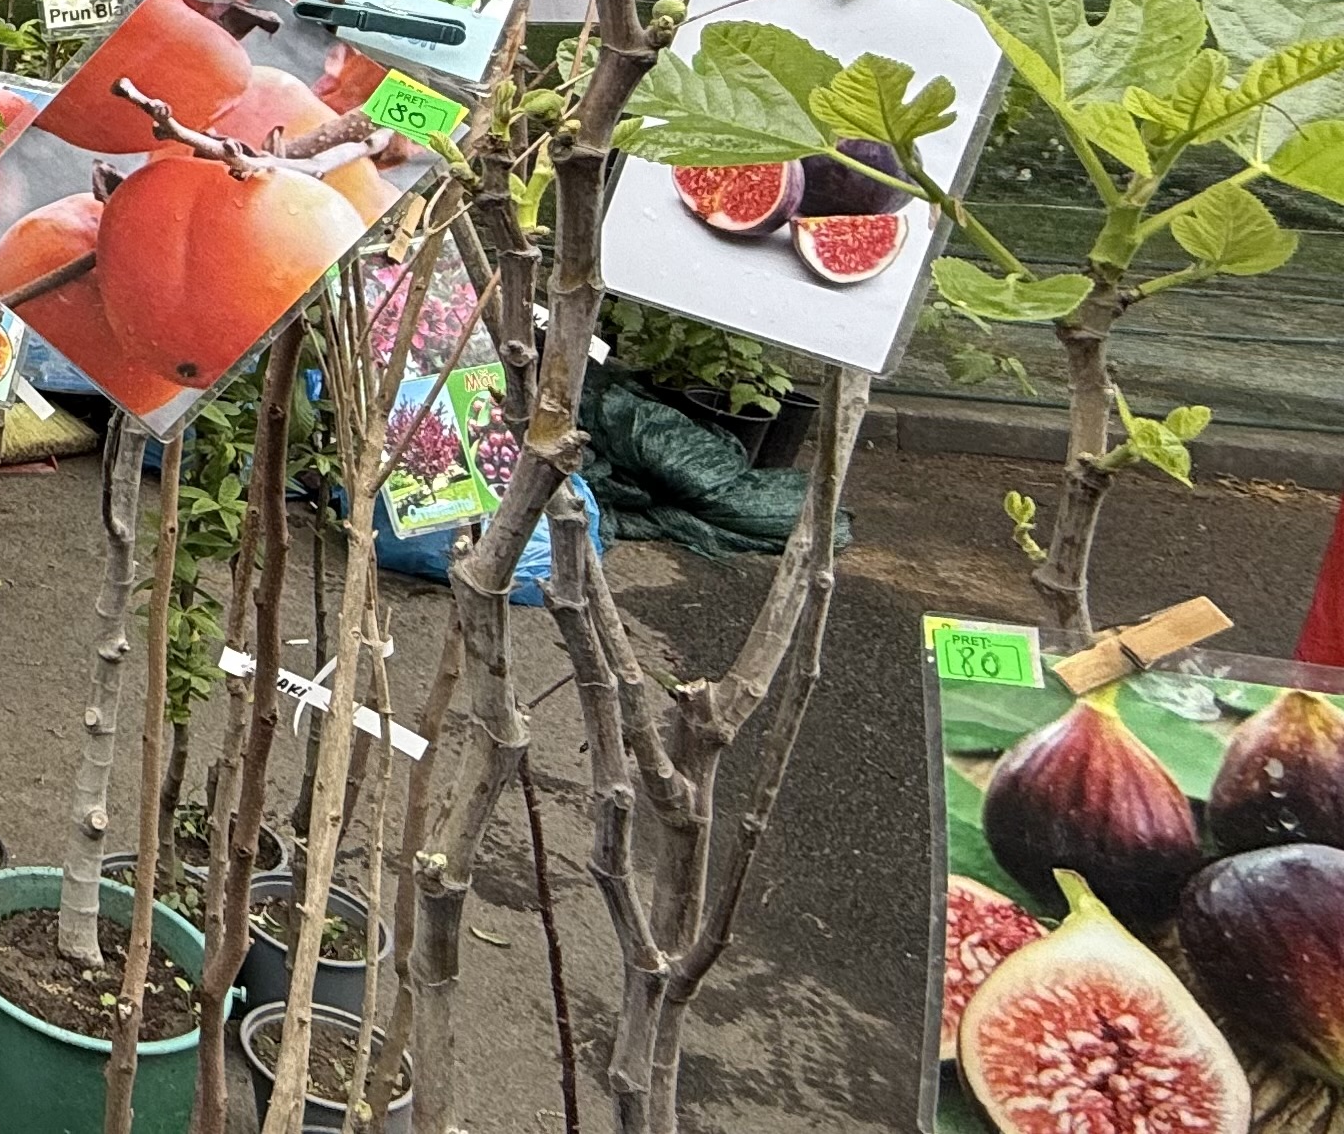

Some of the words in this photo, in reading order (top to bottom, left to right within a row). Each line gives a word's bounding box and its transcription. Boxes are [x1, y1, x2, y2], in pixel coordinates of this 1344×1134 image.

[49, 7, 91, 24] Prun
[388, 103, 426, 129] 80
[464, 369, 499, 393] Măr
[956, 647, 1000, 678] 80
[276, 677, 313, 698] AKI
